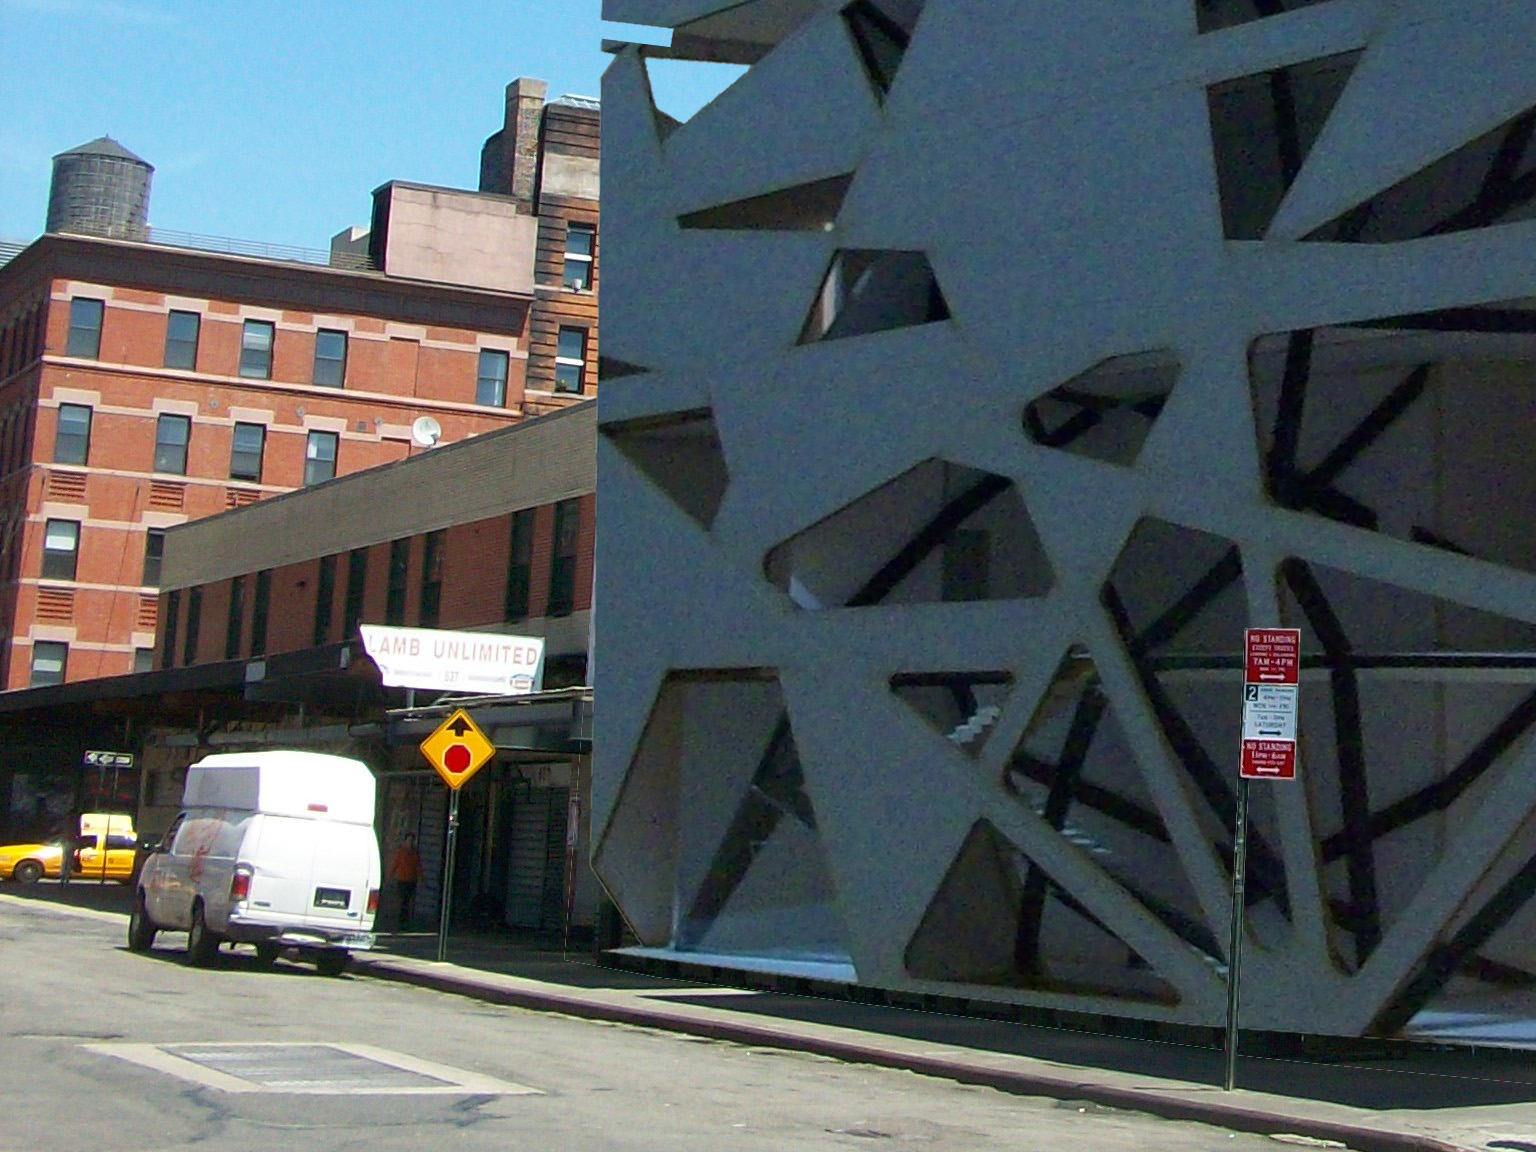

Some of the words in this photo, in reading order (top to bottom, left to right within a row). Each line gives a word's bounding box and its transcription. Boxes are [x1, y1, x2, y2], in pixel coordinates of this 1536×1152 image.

[1250, 634, 1260, 643] NO
[1263, 635, 1296, 644] STANDING
[369, 635, 421, 656] LAMB
[434, 639, 538, 666] UNLIMITED
[1248, 686, 1257, 700] 2
[1246, 741, 1257, 750] NO
[1258, 742, 1292, 752] STANDING
